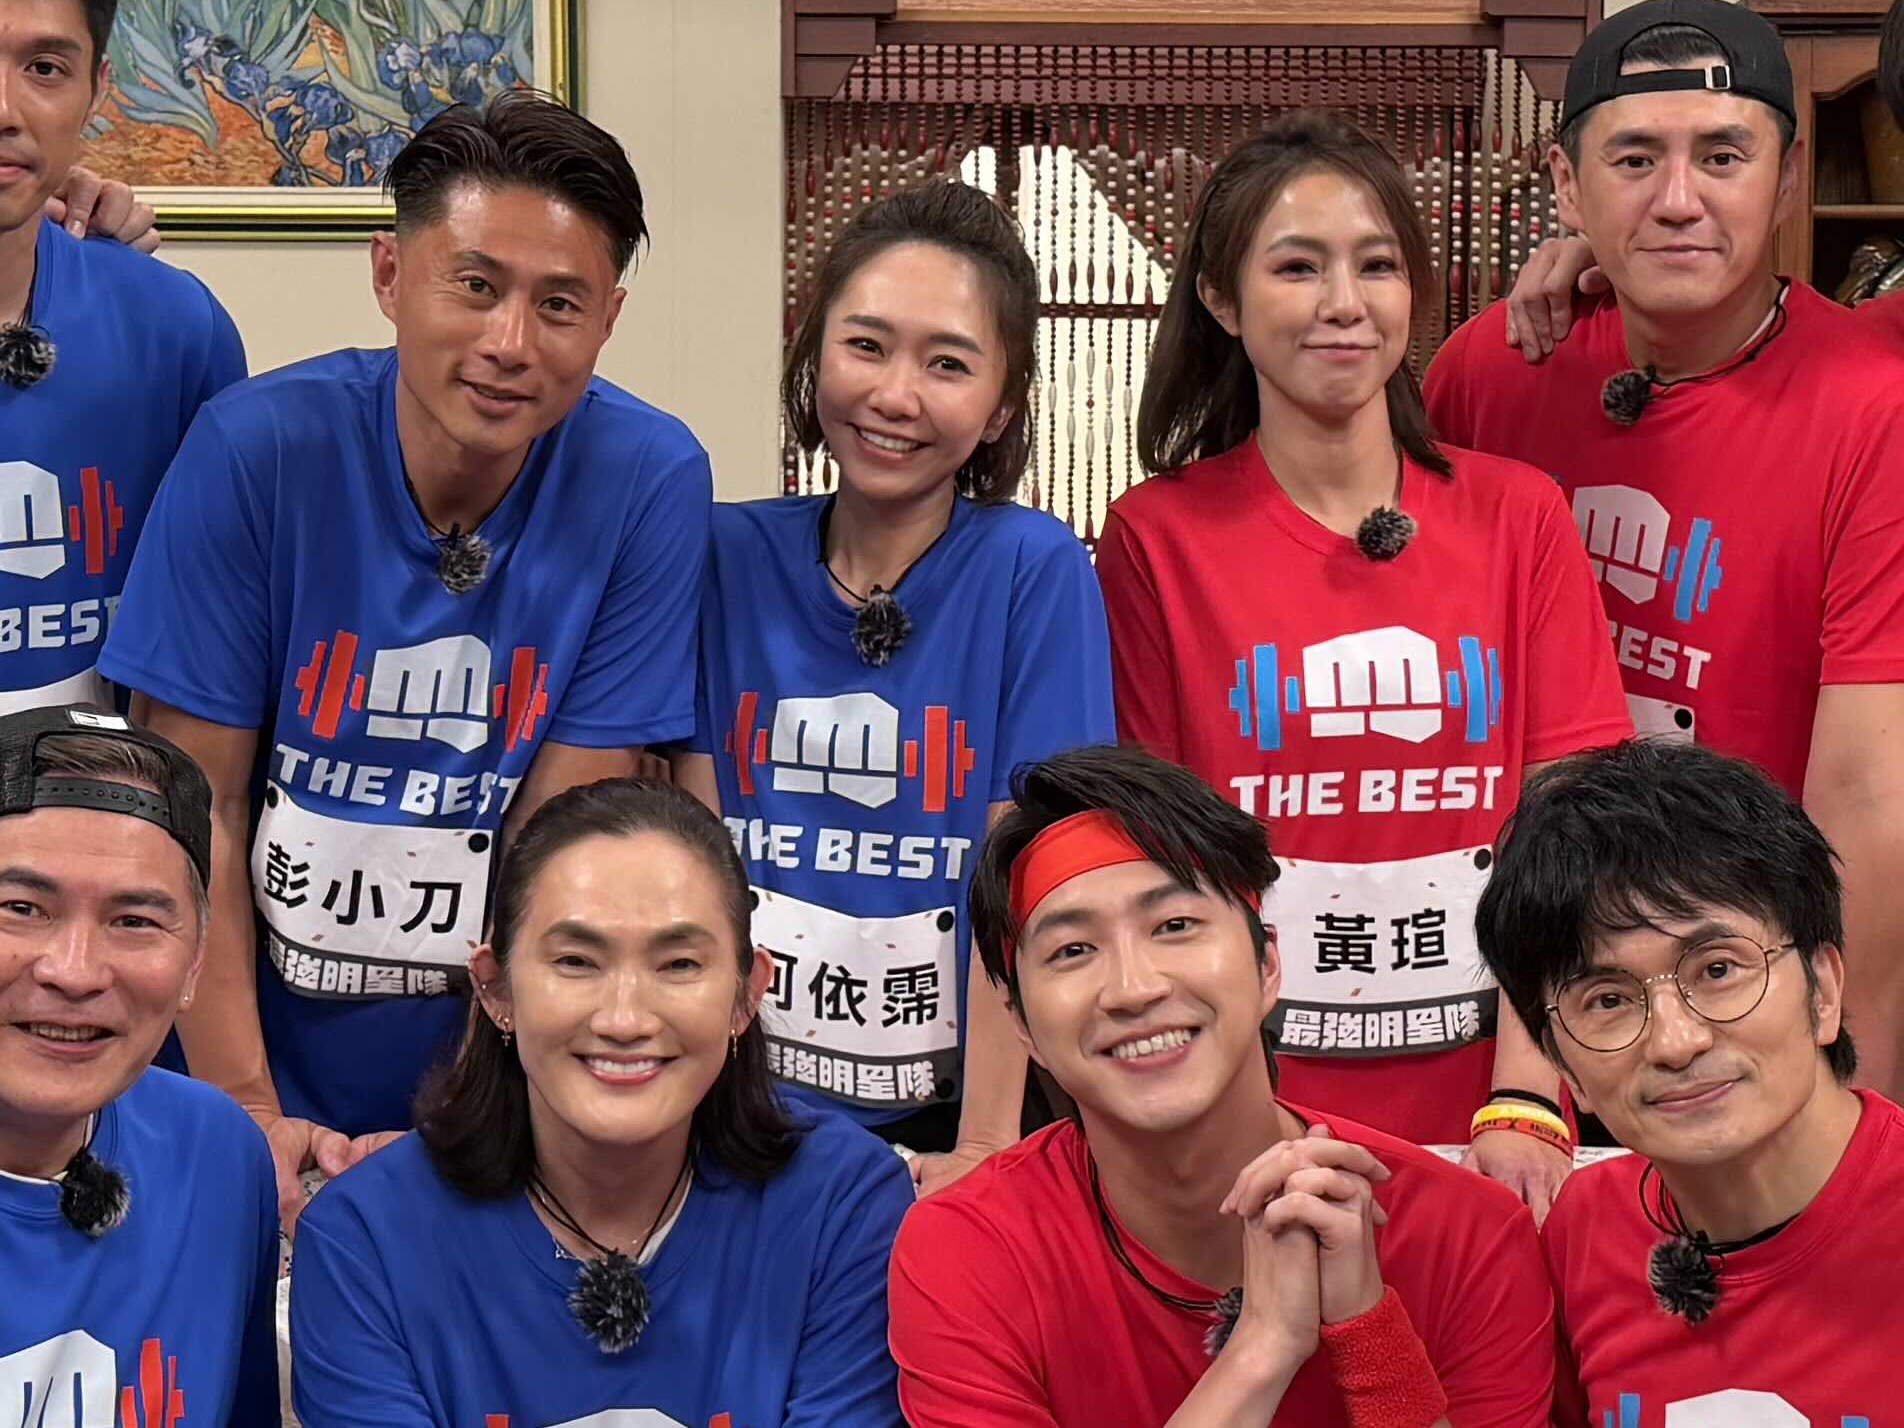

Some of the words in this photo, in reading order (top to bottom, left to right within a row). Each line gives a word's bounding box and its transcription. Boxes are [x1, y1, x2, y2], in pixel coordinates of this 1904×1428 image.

[1607, 619, 1713, 691] EST
[275, 742, 394, 807] THE
[1229, 770, 1345, 818] THE
[1358, 765, 1504, 813] BEST
[723, 816, 804, 869] THE
[814, 827, 972, 880] BEST
[263, 840, 464, 934] 彭小刀
[1313, 907, 1449, 974] 黃瑄
[1279, 1000, 1480, 1050] 最強明星隊
